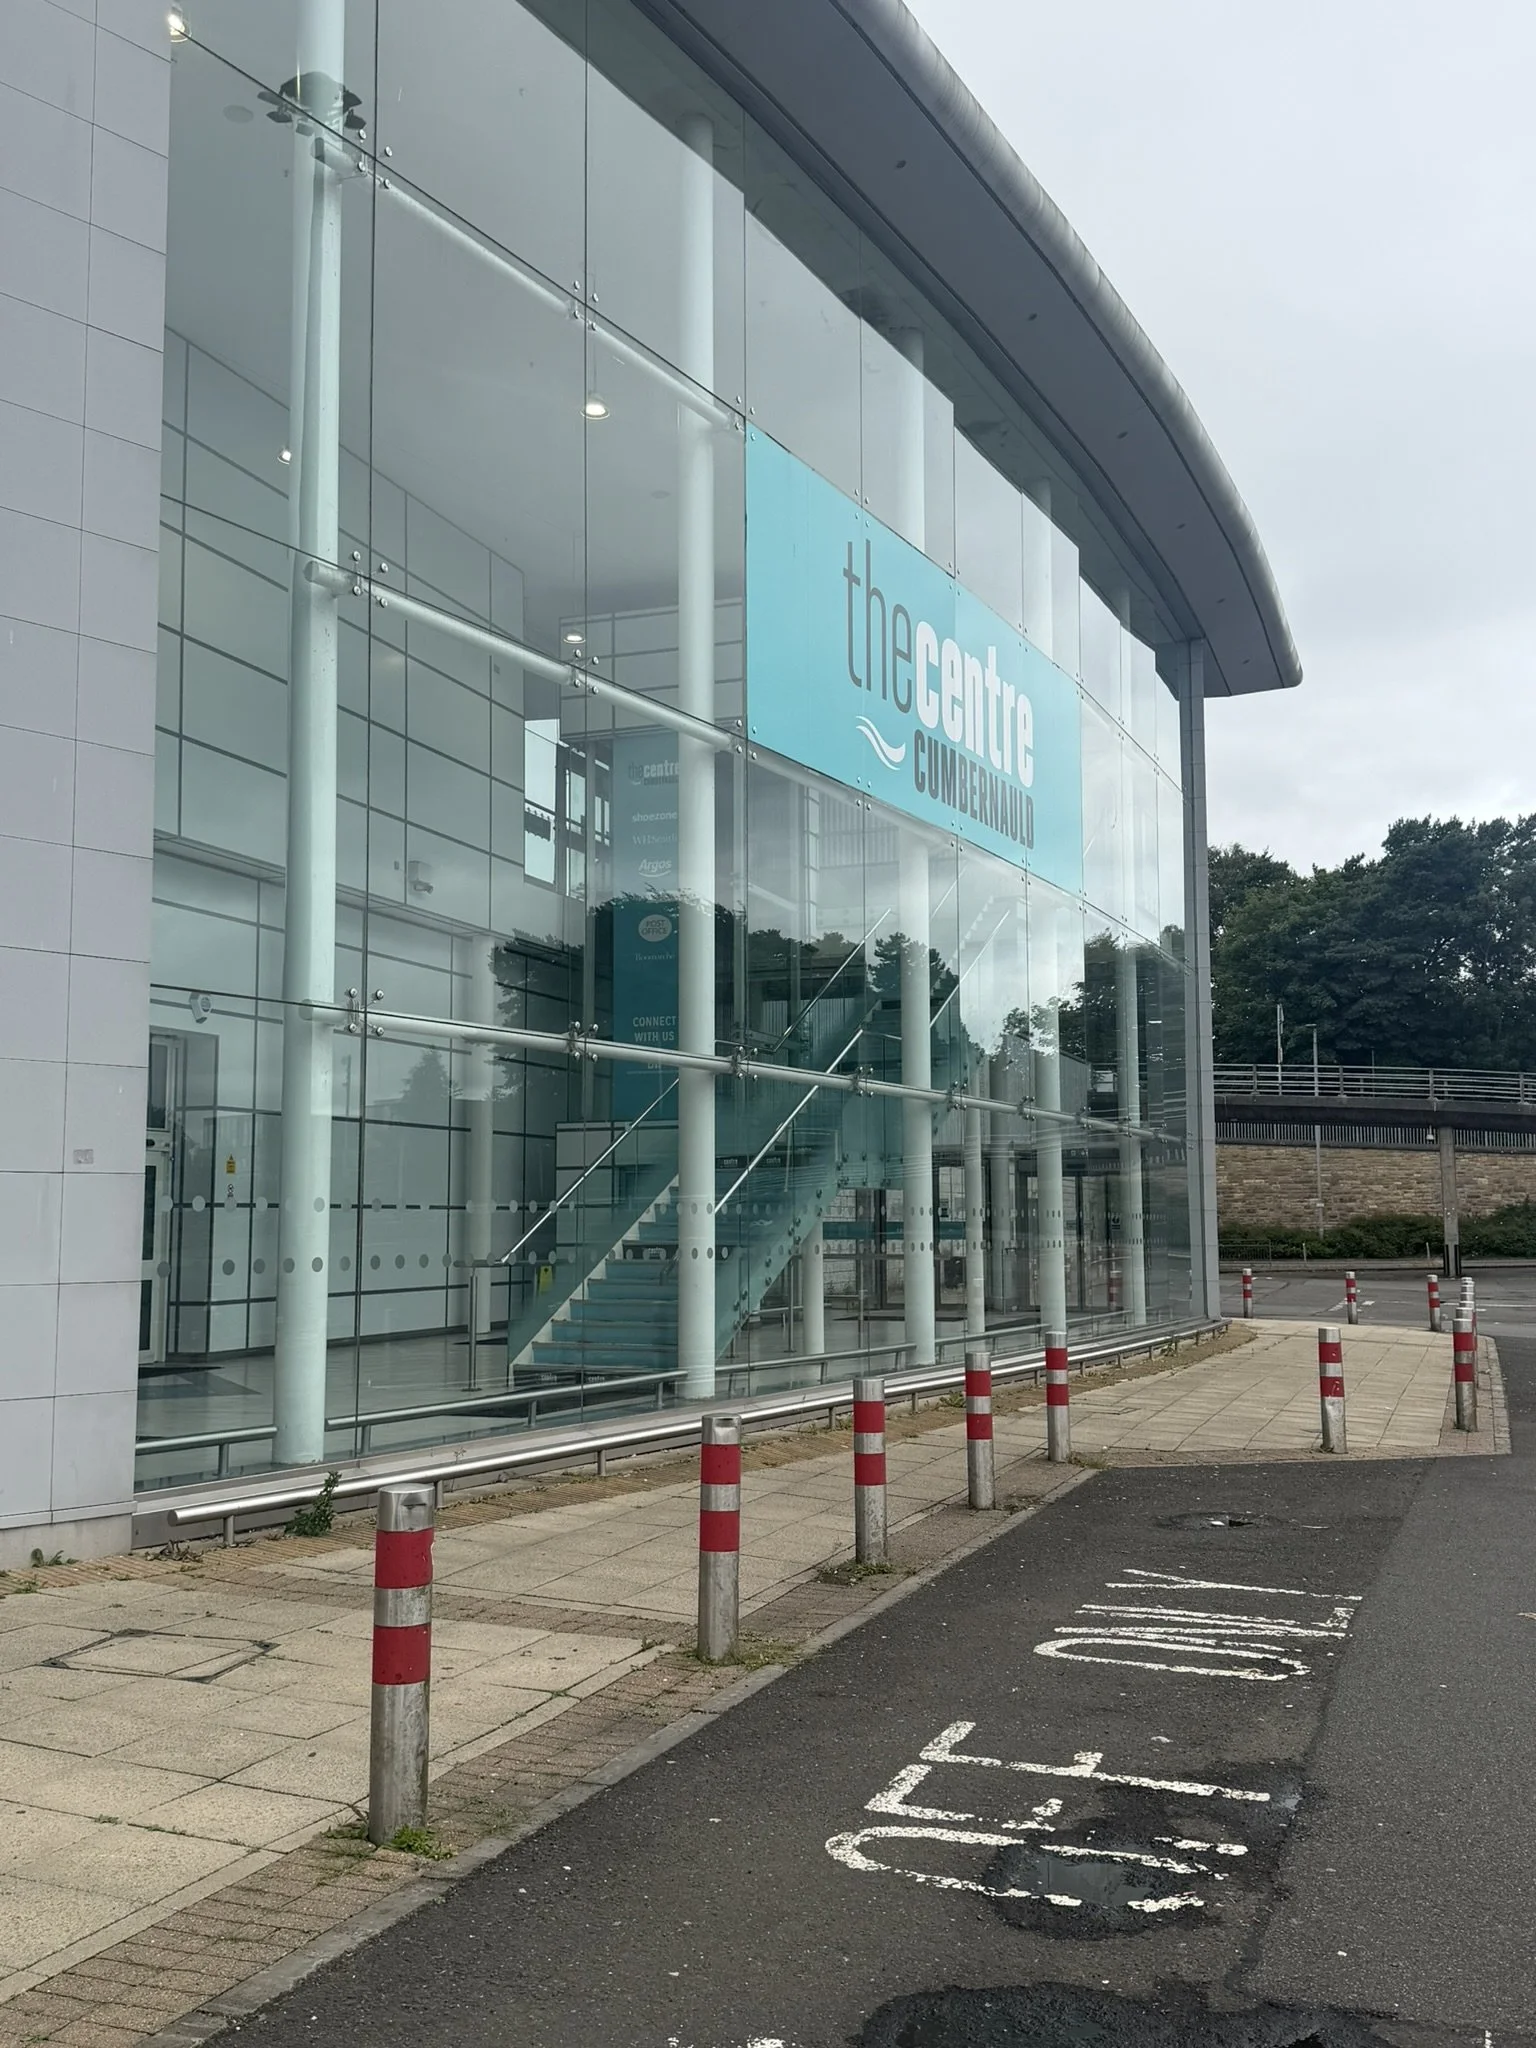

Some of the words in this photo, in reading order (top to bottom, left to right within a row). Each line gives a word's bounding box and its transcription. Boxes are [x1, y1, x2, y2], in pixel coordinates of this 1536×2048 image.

[914, 728, 1034, 850] CUMBERNAULD
[639, 858, 672, 872] Argos
[646, 919, 666, 927] POST
[641, 927, 667, 935] OFFICE
[632, 1015, 677, 1027] CONNECT
[634, 1031, 659, 1042] WITH
[662, 1030, 675, 1042] US
[1033, 1567, 1363, 1683] ONLY
